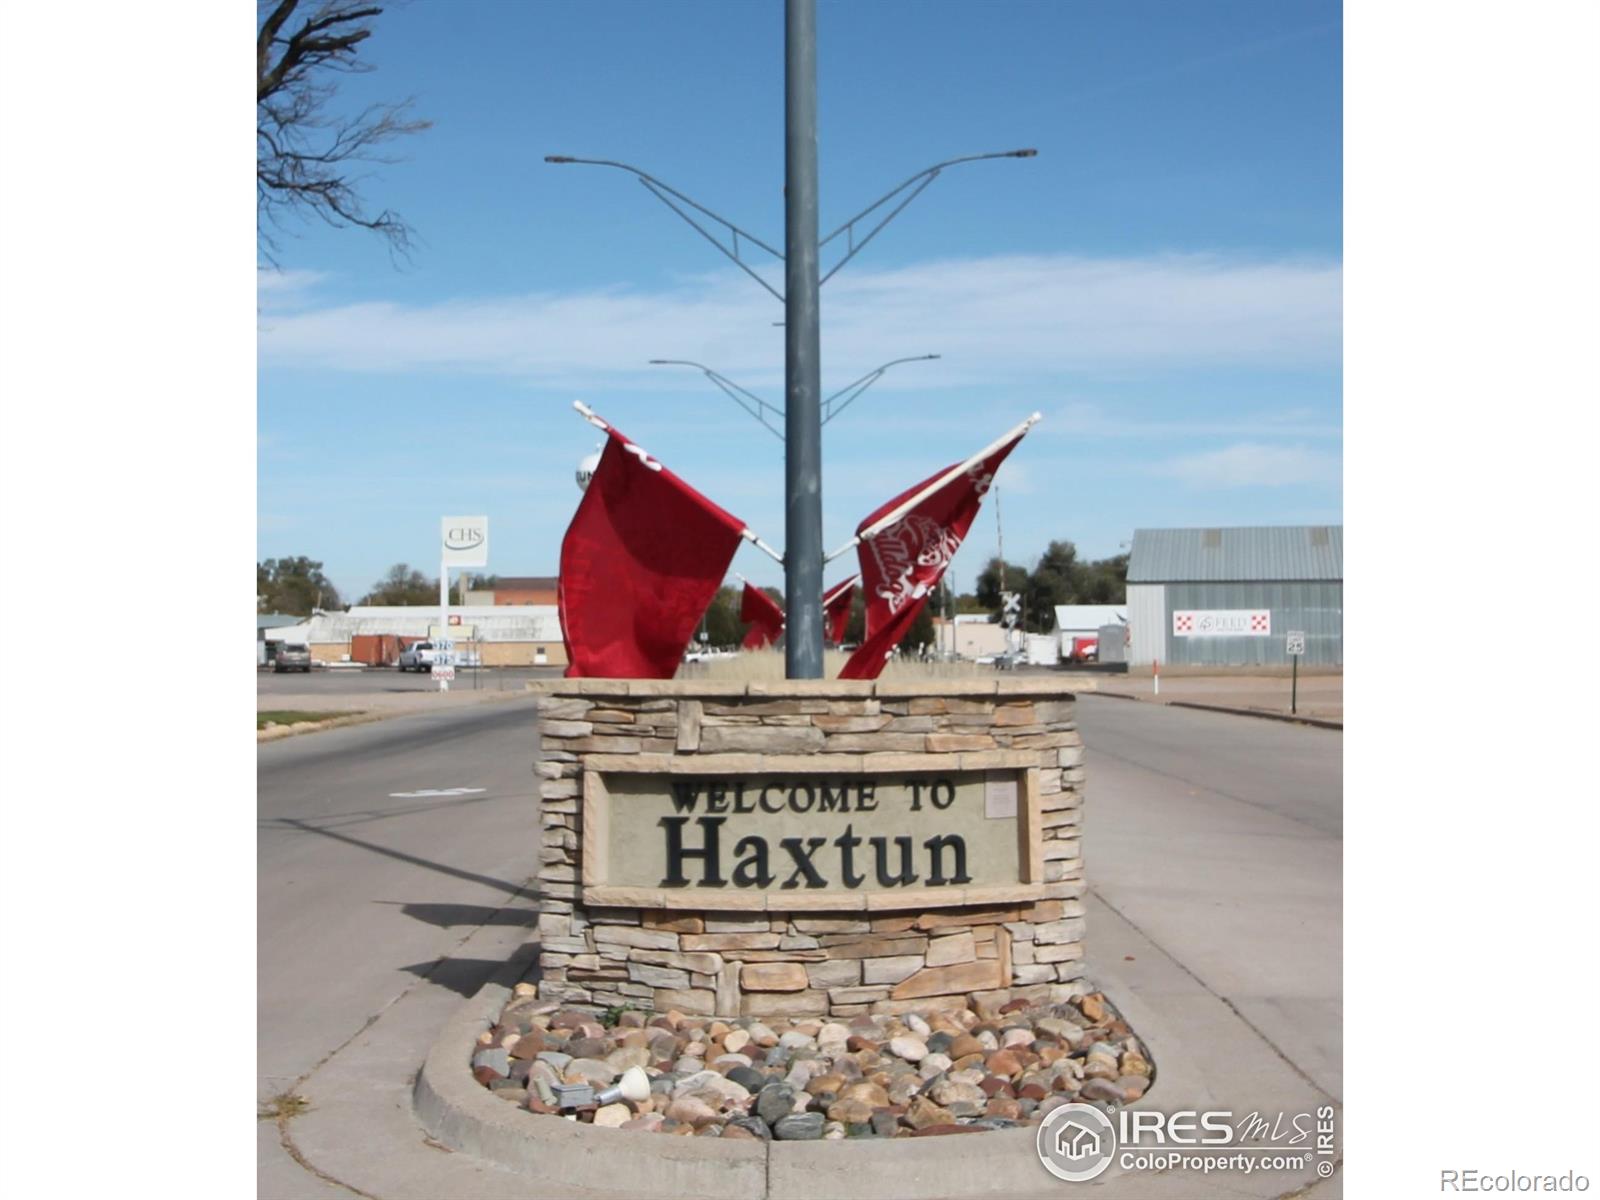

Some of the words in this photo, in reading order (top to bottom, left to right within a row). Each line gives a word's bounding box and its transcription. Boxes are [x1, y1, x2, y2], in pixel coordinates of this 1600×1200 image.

[449, 527, 482, 542] CHS
[670, 781, 879, 814] WELCOME
[904, 778, 956, 811] TO
[657, 815, 973, 889] Haxtun
